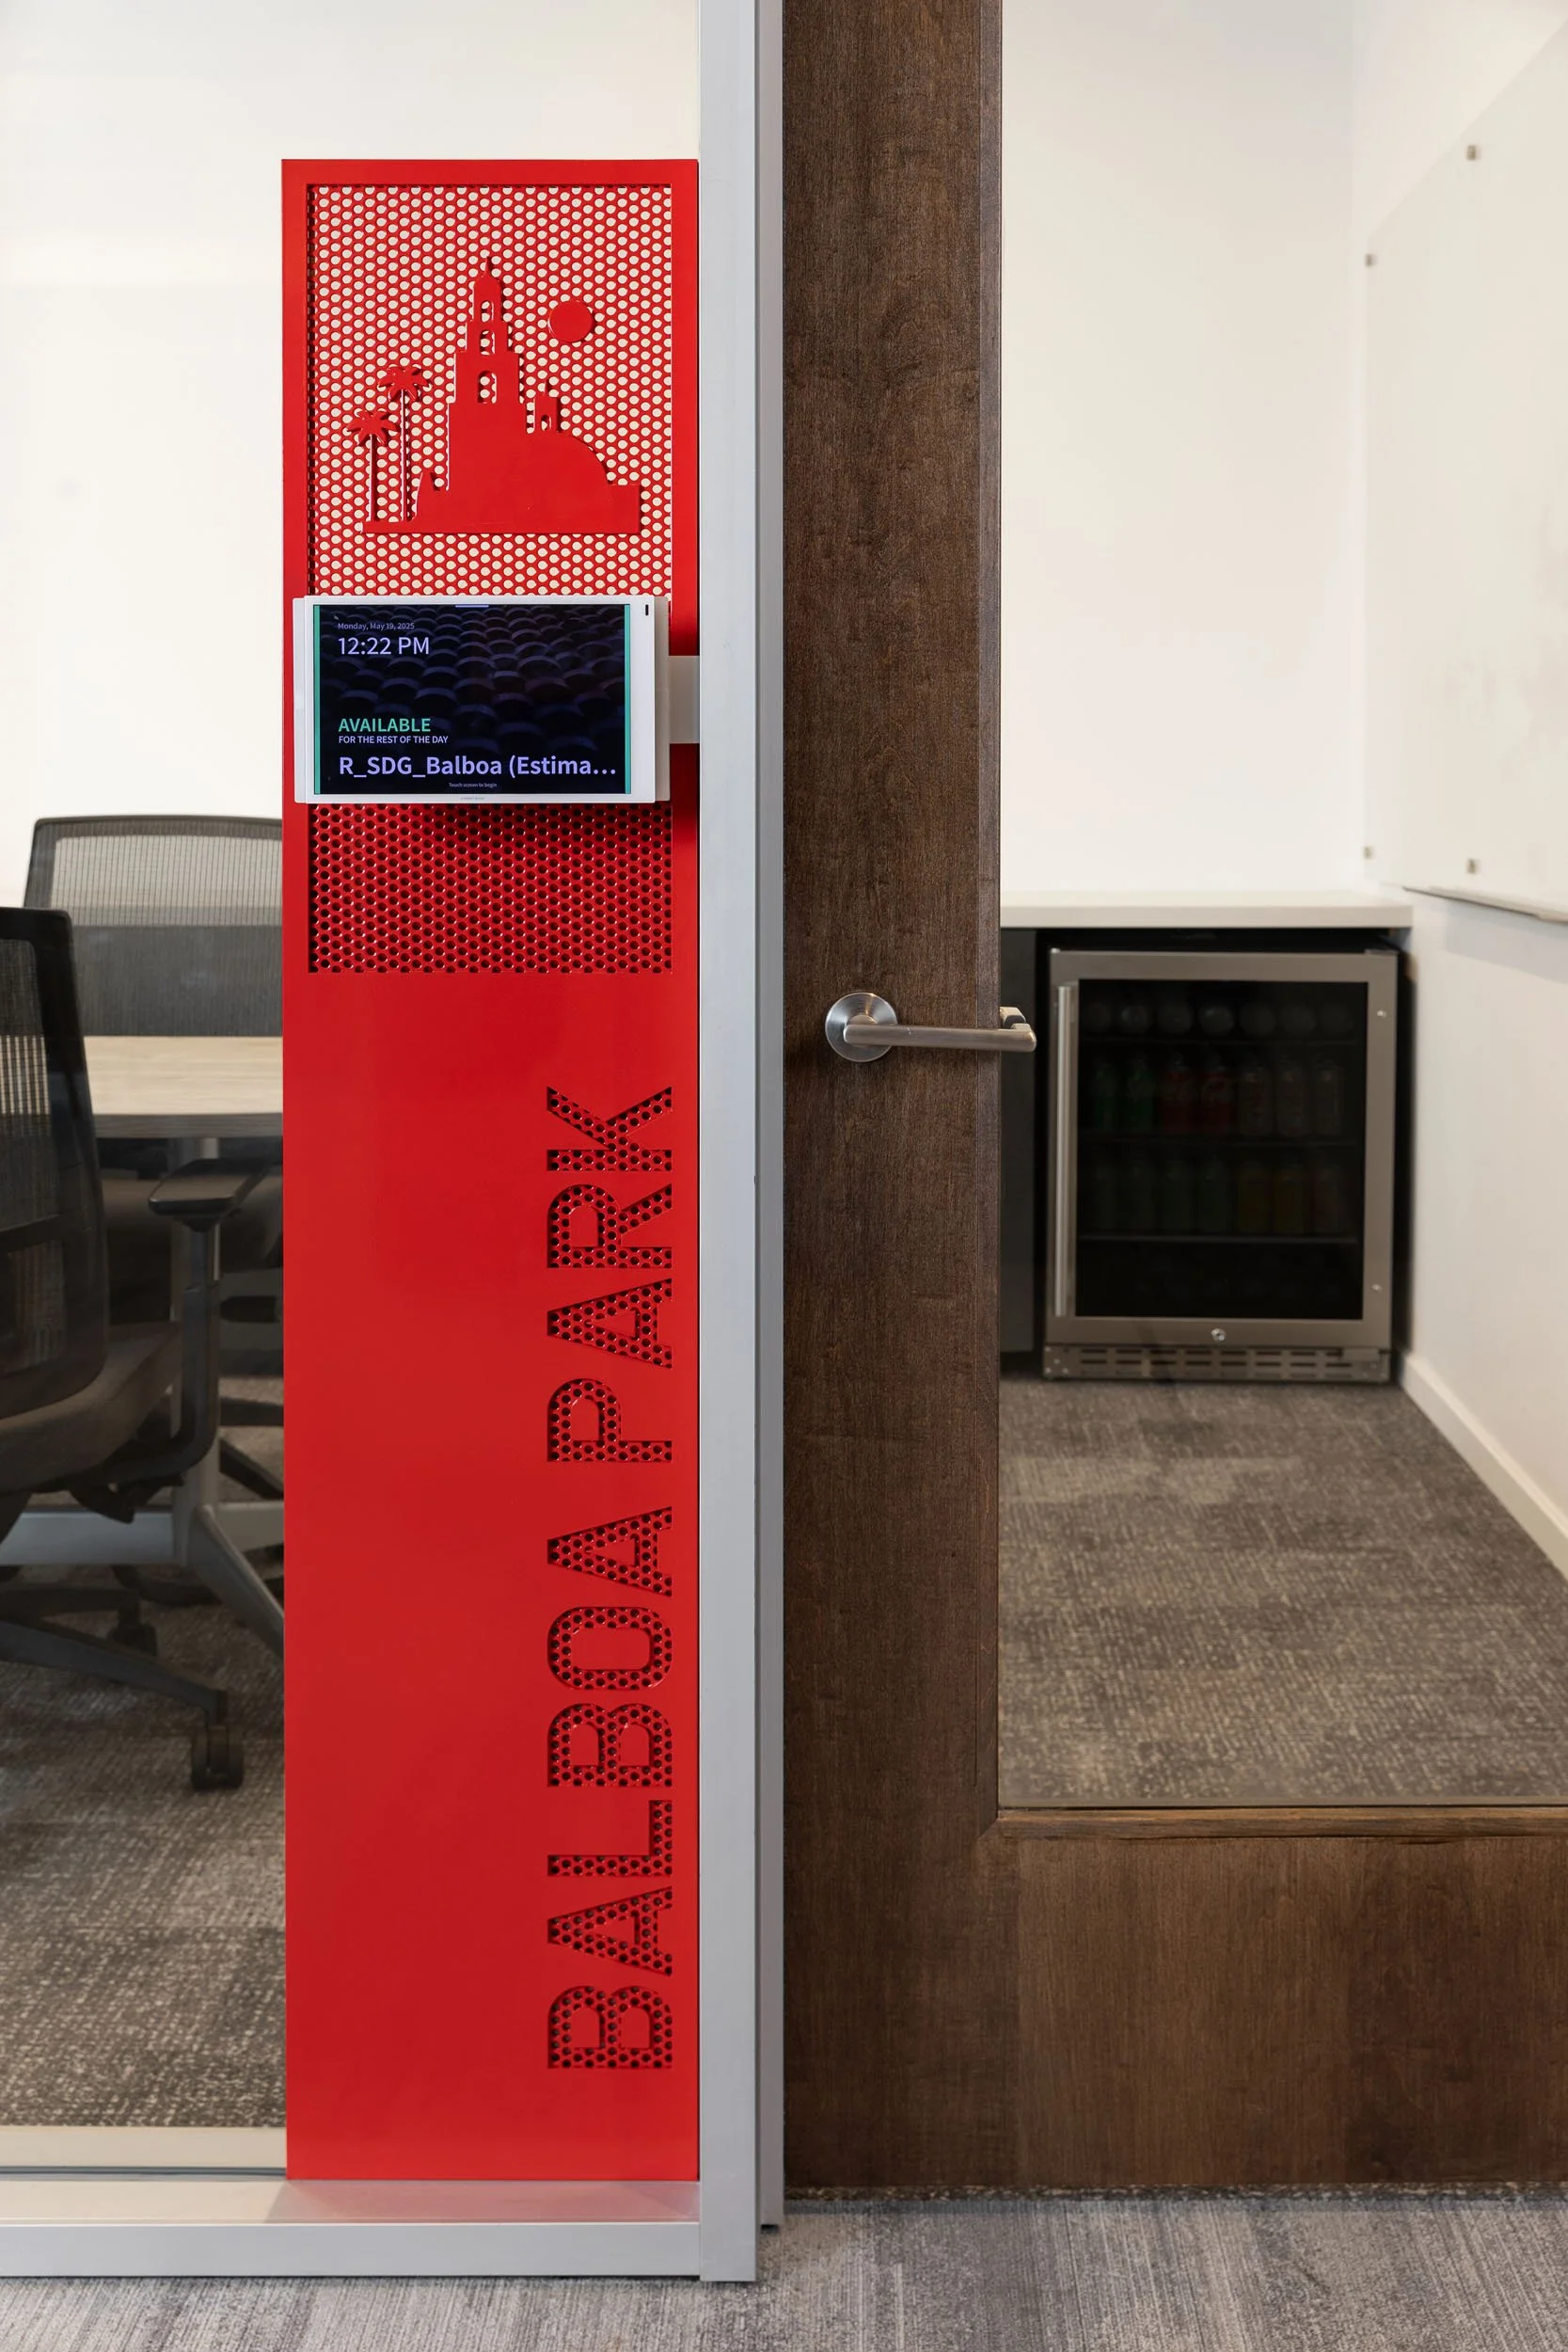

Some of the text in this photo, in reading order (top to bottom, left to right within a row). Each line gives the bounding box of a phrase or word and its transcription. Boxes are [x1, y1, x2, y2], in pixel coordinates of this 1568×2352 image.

[338, 622, 369, 631] Monday,
[370, 622, 386, 631] May
[386, 622, 396, 630] 19,
[338, 637, 430, 655] 12:22 PM
[339, 718, 431, 732] AVAILABLE
[339, 735, 449, 744] FOR THE REST OF THE DAY
[339, 755, 502, 778] R_SDG_Balboa
[546, 1085, 673, 2070] BALBOA PARK
